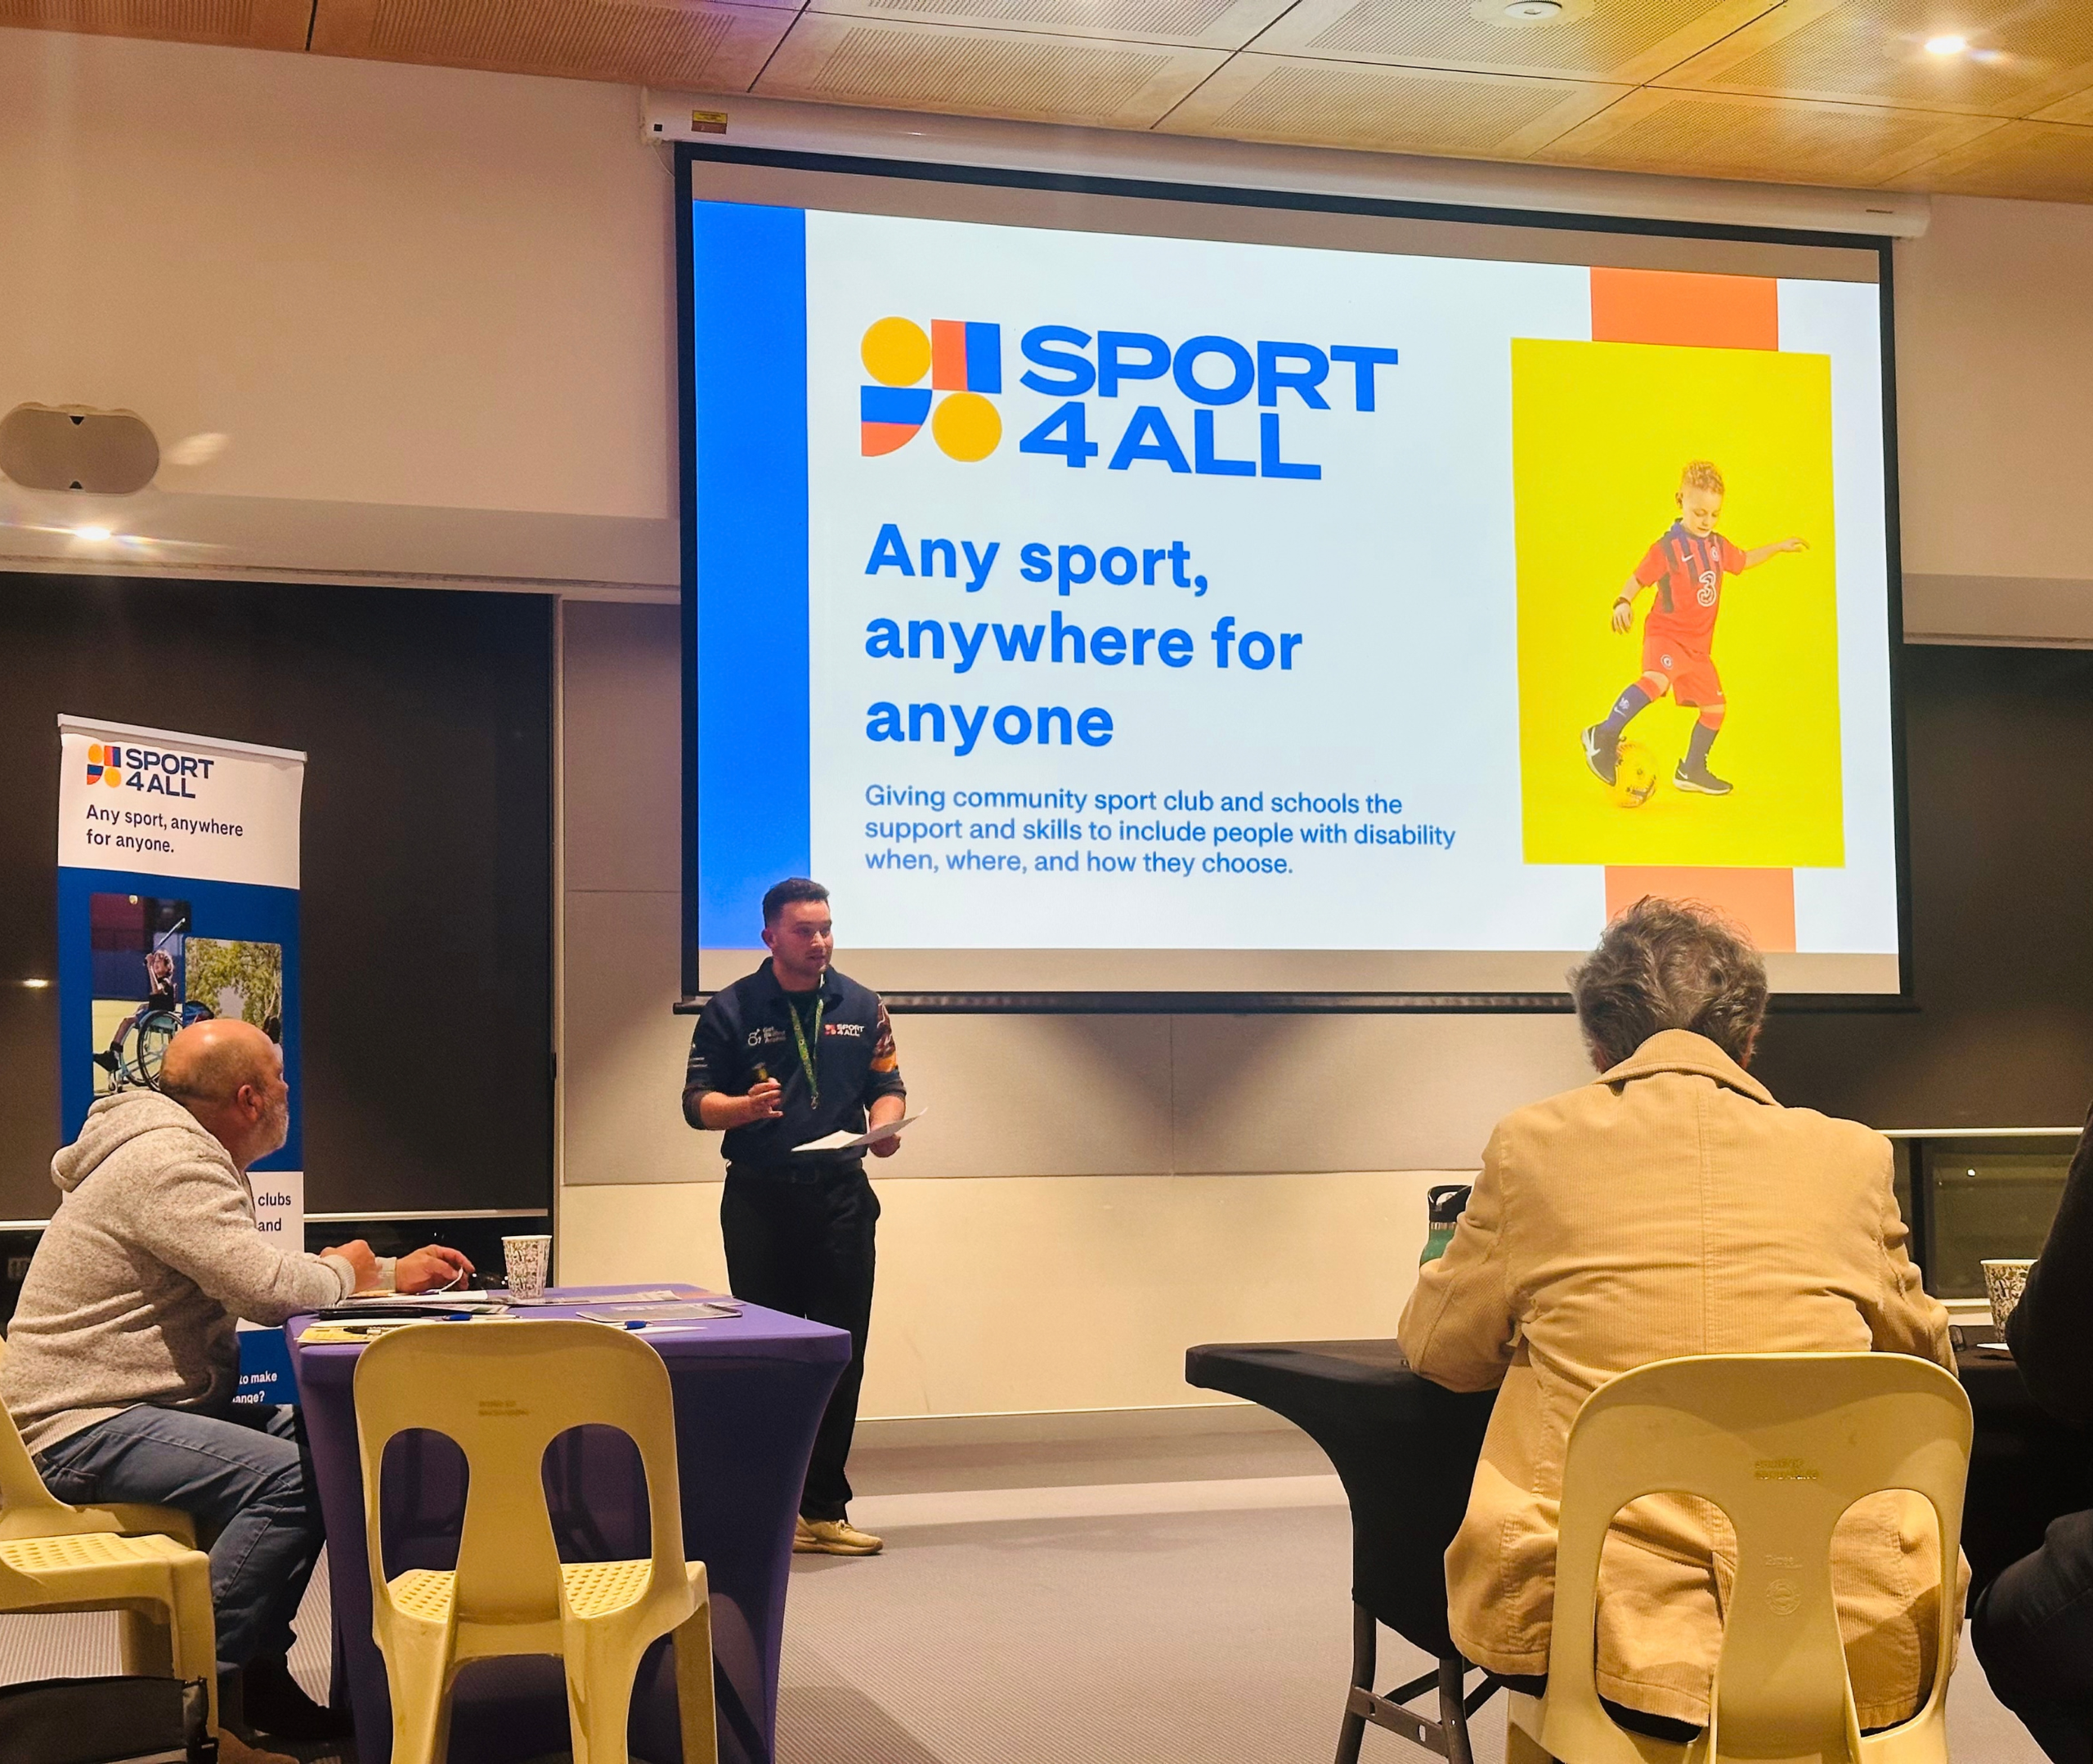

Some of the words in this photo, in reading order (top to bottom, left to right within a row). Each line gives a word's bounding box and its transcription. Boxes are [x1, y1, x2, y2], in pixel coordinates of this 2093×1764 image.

[1019, 325, 1399, 413] SPORT
[864, 523, 1001, 593] Any
[1019, 540, 1208, 598] sport,
[864, 610, 1194, 674] anywhere
[1210, 616, 1303, 671] for
[865, 701, 1114, 758] anyone
[125, 748, 215, 780] SPORT
[865, 784, 946, 813] Giving
[952, 787, 1088, 814] community
[1094, 790, 1157, 815] sport
[1163, 789, 1215, 813] club
[1220, 790, 1264, 813] and
[1271, 791, 1360, 814] schools
[1365, 792, 1403, 815] the
[86, 804, 120, 826] Any
[124, 811, 168, 831] sport,
[171, 817, 244, 837] anywhere
[865, 819, 963, 844] support
[969, 817, 1015, 840] and
[1023, 817, 1082, 841] skills
[1087, 822, 1112, 841] to
[1119, 820, 1207, 843] include
[1212, 822, 1294, 848] people
[1299, 822, 1347, 844] with
[1353, 823, 1456, 850] disability
[86, 828, 111, 846] for
[115, 835, 174, 853] anyone.
[865, 848, 939, 873] when,
[945, 848, 1028, 875] where,
[1034, 849, 1079, 872] and
[1087, 850, 1137, 873] how
[1142, 850, 1196, 878] they
[1201, 851, 1293, 875] choose.
[836, 1023, 865, 1032] SPORT
[258, 1191, 291, 1207] clubs
[258, 1217, 282, 1232] and
[250, 1370, 278, 1384] make
[232, 1390, 266, 1404] ange?
